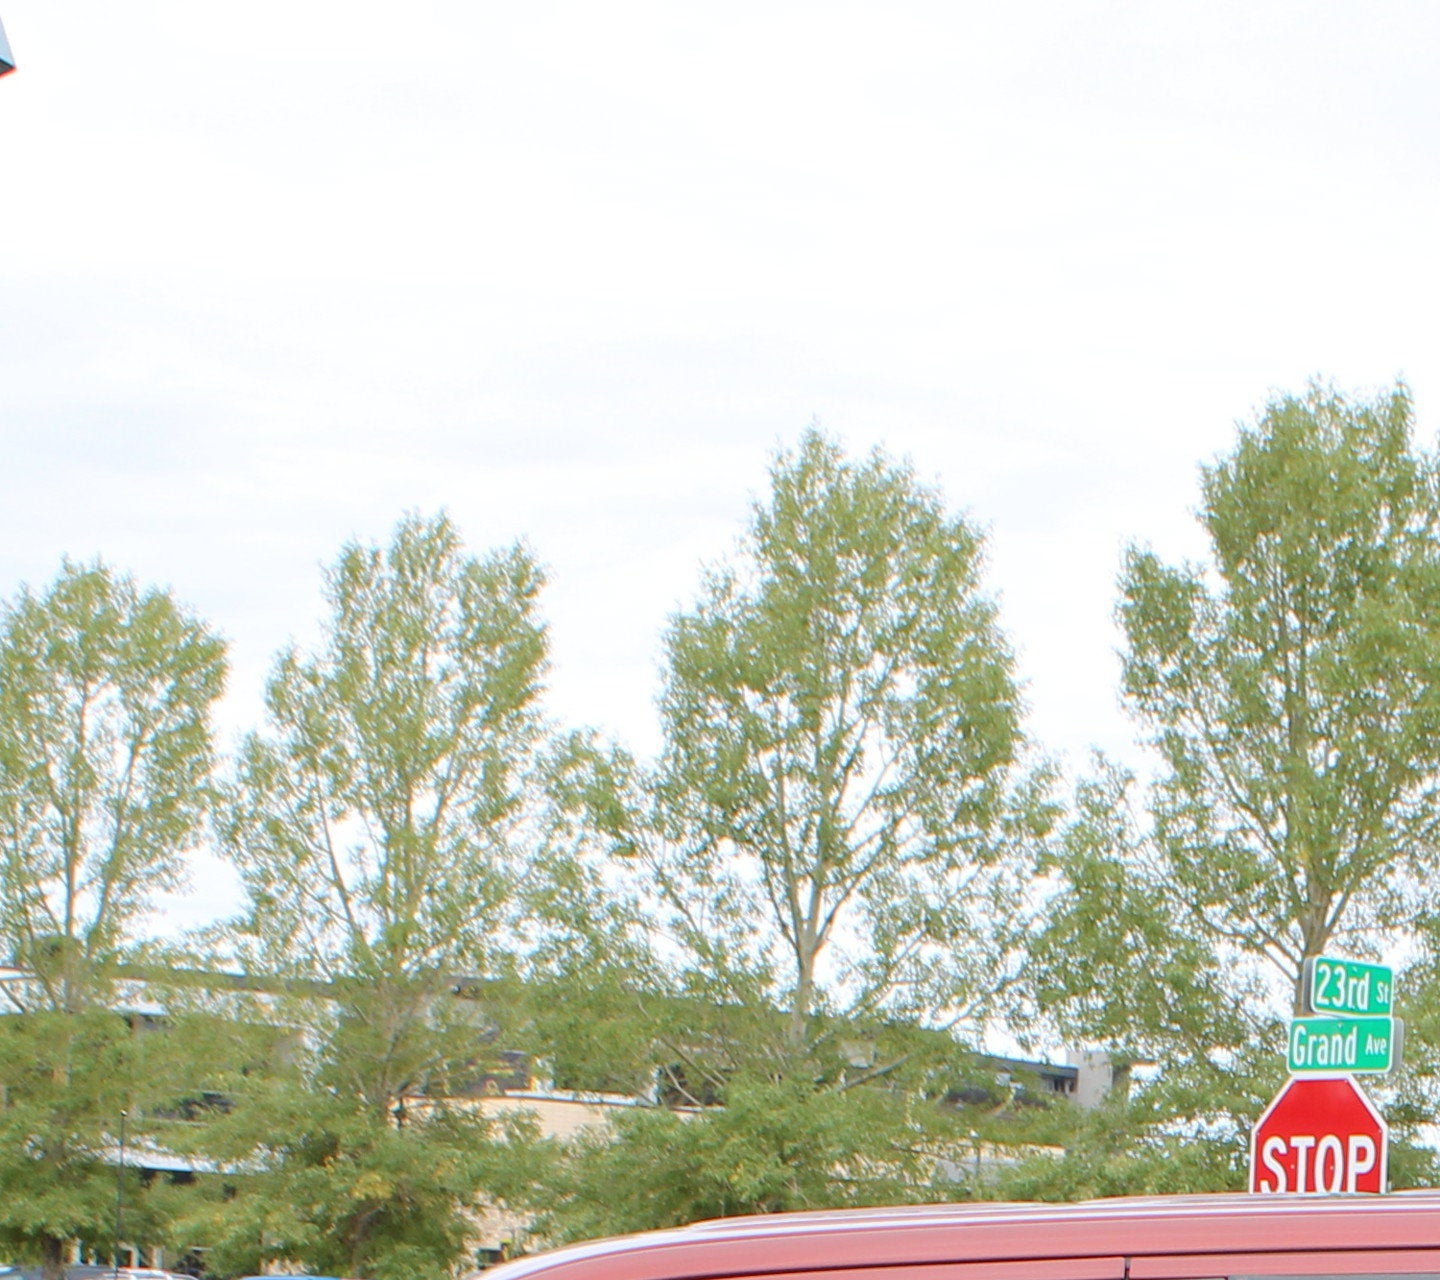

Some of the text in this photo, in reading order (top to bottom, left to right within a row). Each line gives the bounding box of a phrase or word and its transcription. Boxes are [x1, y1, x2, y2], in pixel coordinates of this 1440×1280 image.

[1315, 965, 1389, 1011] 23rd St
[1292, 1024, 1387, 1066] Grand Ave
[1260, 1134, 1376, 1193] STOP
